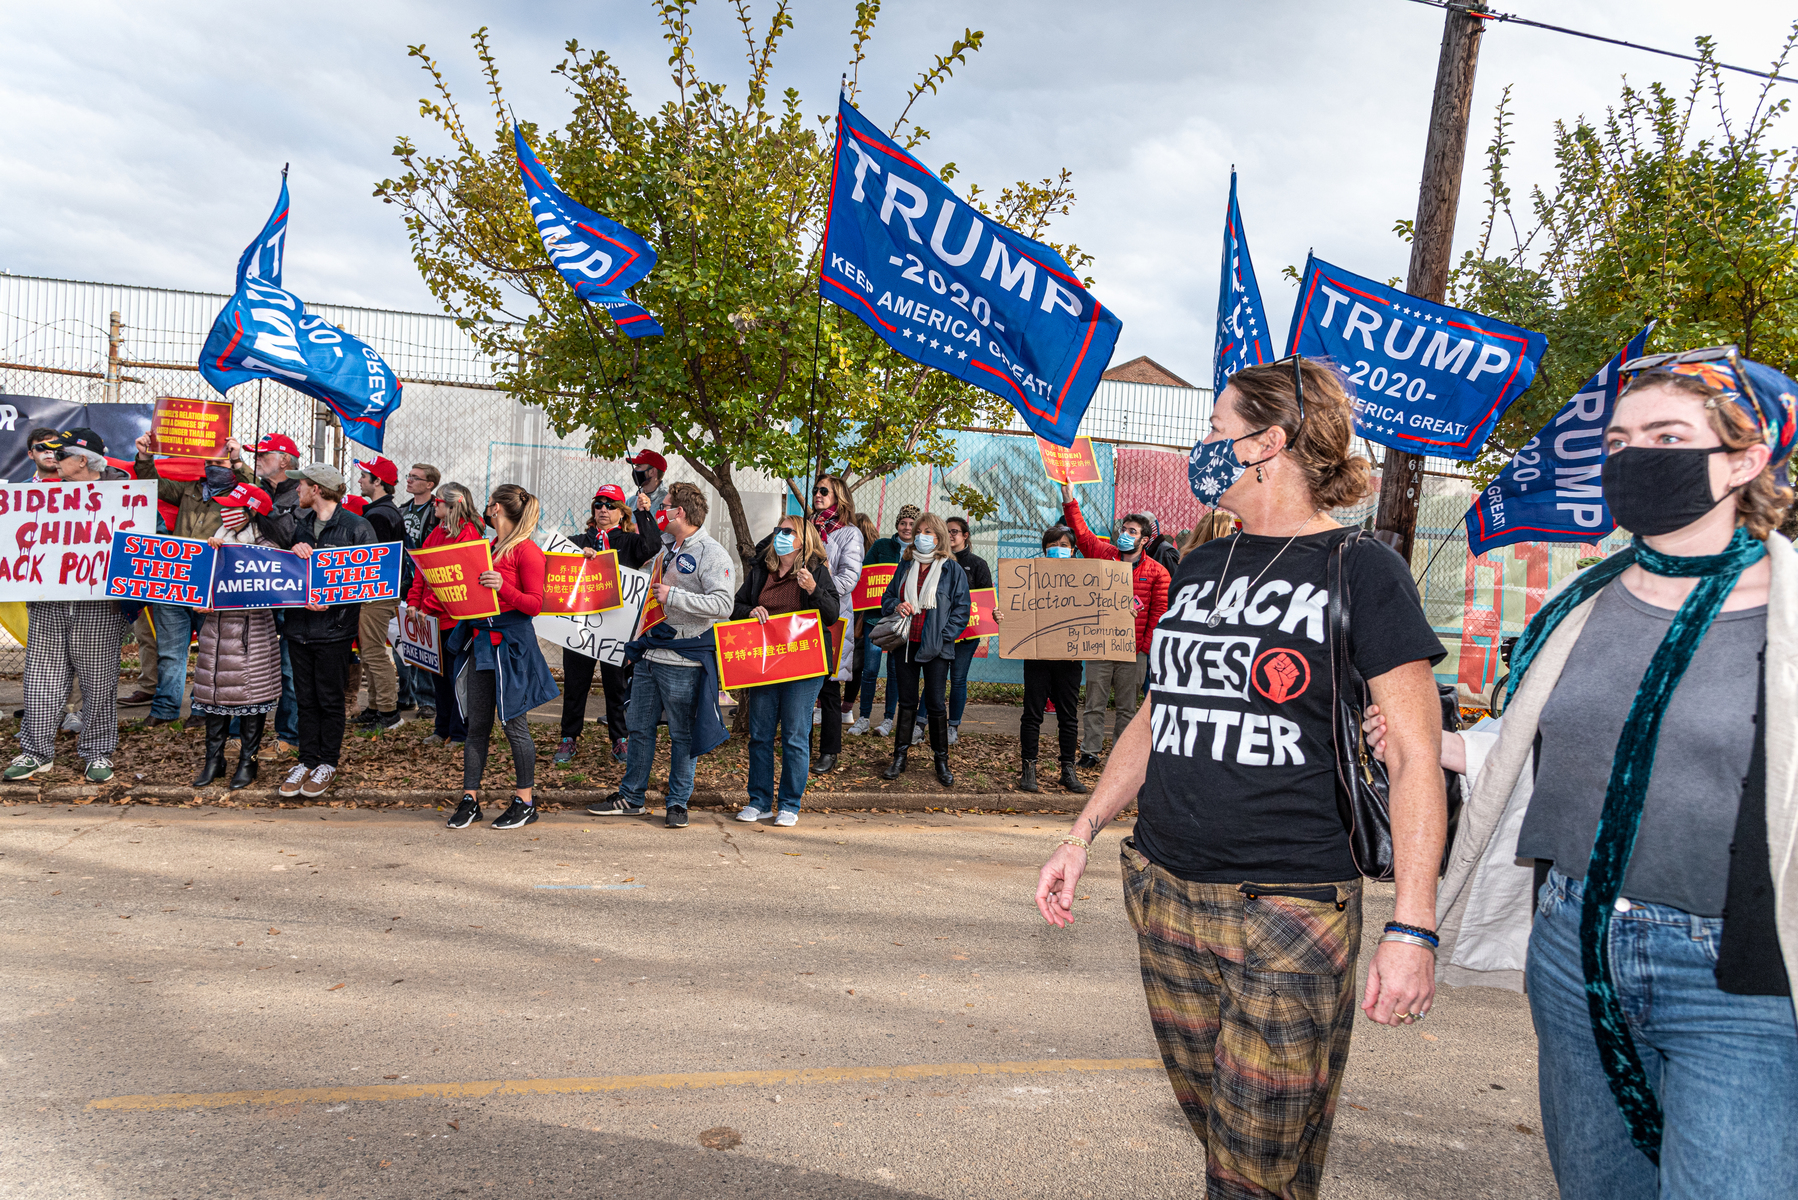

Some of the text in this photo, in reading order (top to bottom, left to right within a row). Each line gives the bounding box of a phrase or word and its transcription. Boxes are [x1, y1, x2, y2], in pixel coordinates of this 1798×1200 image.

[848, 136, 1082, 318] TRUMP
[831, 252, 874, 294] KEEP
[877, 290, 981, 347] AMERICA
[889, 253, 1005, 332] -2020-
[1320, 284, 1511, 382] TRUMP
[1340, 360, 1436, 402] -2020-
[174, 419, 196, 428] CHINESE
[197, 421, 210, 430] SPY
[1347, 393, 1469, 437] ERICA GREAT!
[184, 437, 216, 447] CAMPAIGN
[189, 429, 204, 438] THAN
[205, 431, 216, 439] HIS
[1411, 472, 1419, 484] A
[122, 485, 148, 508] in
[125, 535, 202, 561] STOP
[317, 547, 389, 567] STOP
[0, 553, 45, 584] ACK
[132, 558, 192, 582] THE
[235, 560, 282, 574] SAVE
[324, 565, 381, 584] THE
[547, 573, 566, 583] (JOE
[1007, 564, 1078, 590] Shame
[1083, 573, 1100, 587] on
[111, 576, 202, 604] STEAL
[217, 578, 303, 593] AMERICA!
[868, 574, 894, 586] WHER
[311, 581, 394, 604] STEAL
[432, 583, 468, 602] UNTER?
[1010, 592, 1081, 611] Election
[1159, 576, 1329, 644] BLACK
[567, 628, 625, 662] SAFE
[1068, 627, 1080, 641] By
[403, 641, 419, 660] FAKE
[419, 649, 438, 667] NEWS
[1067, 641, 1078, 657] By
